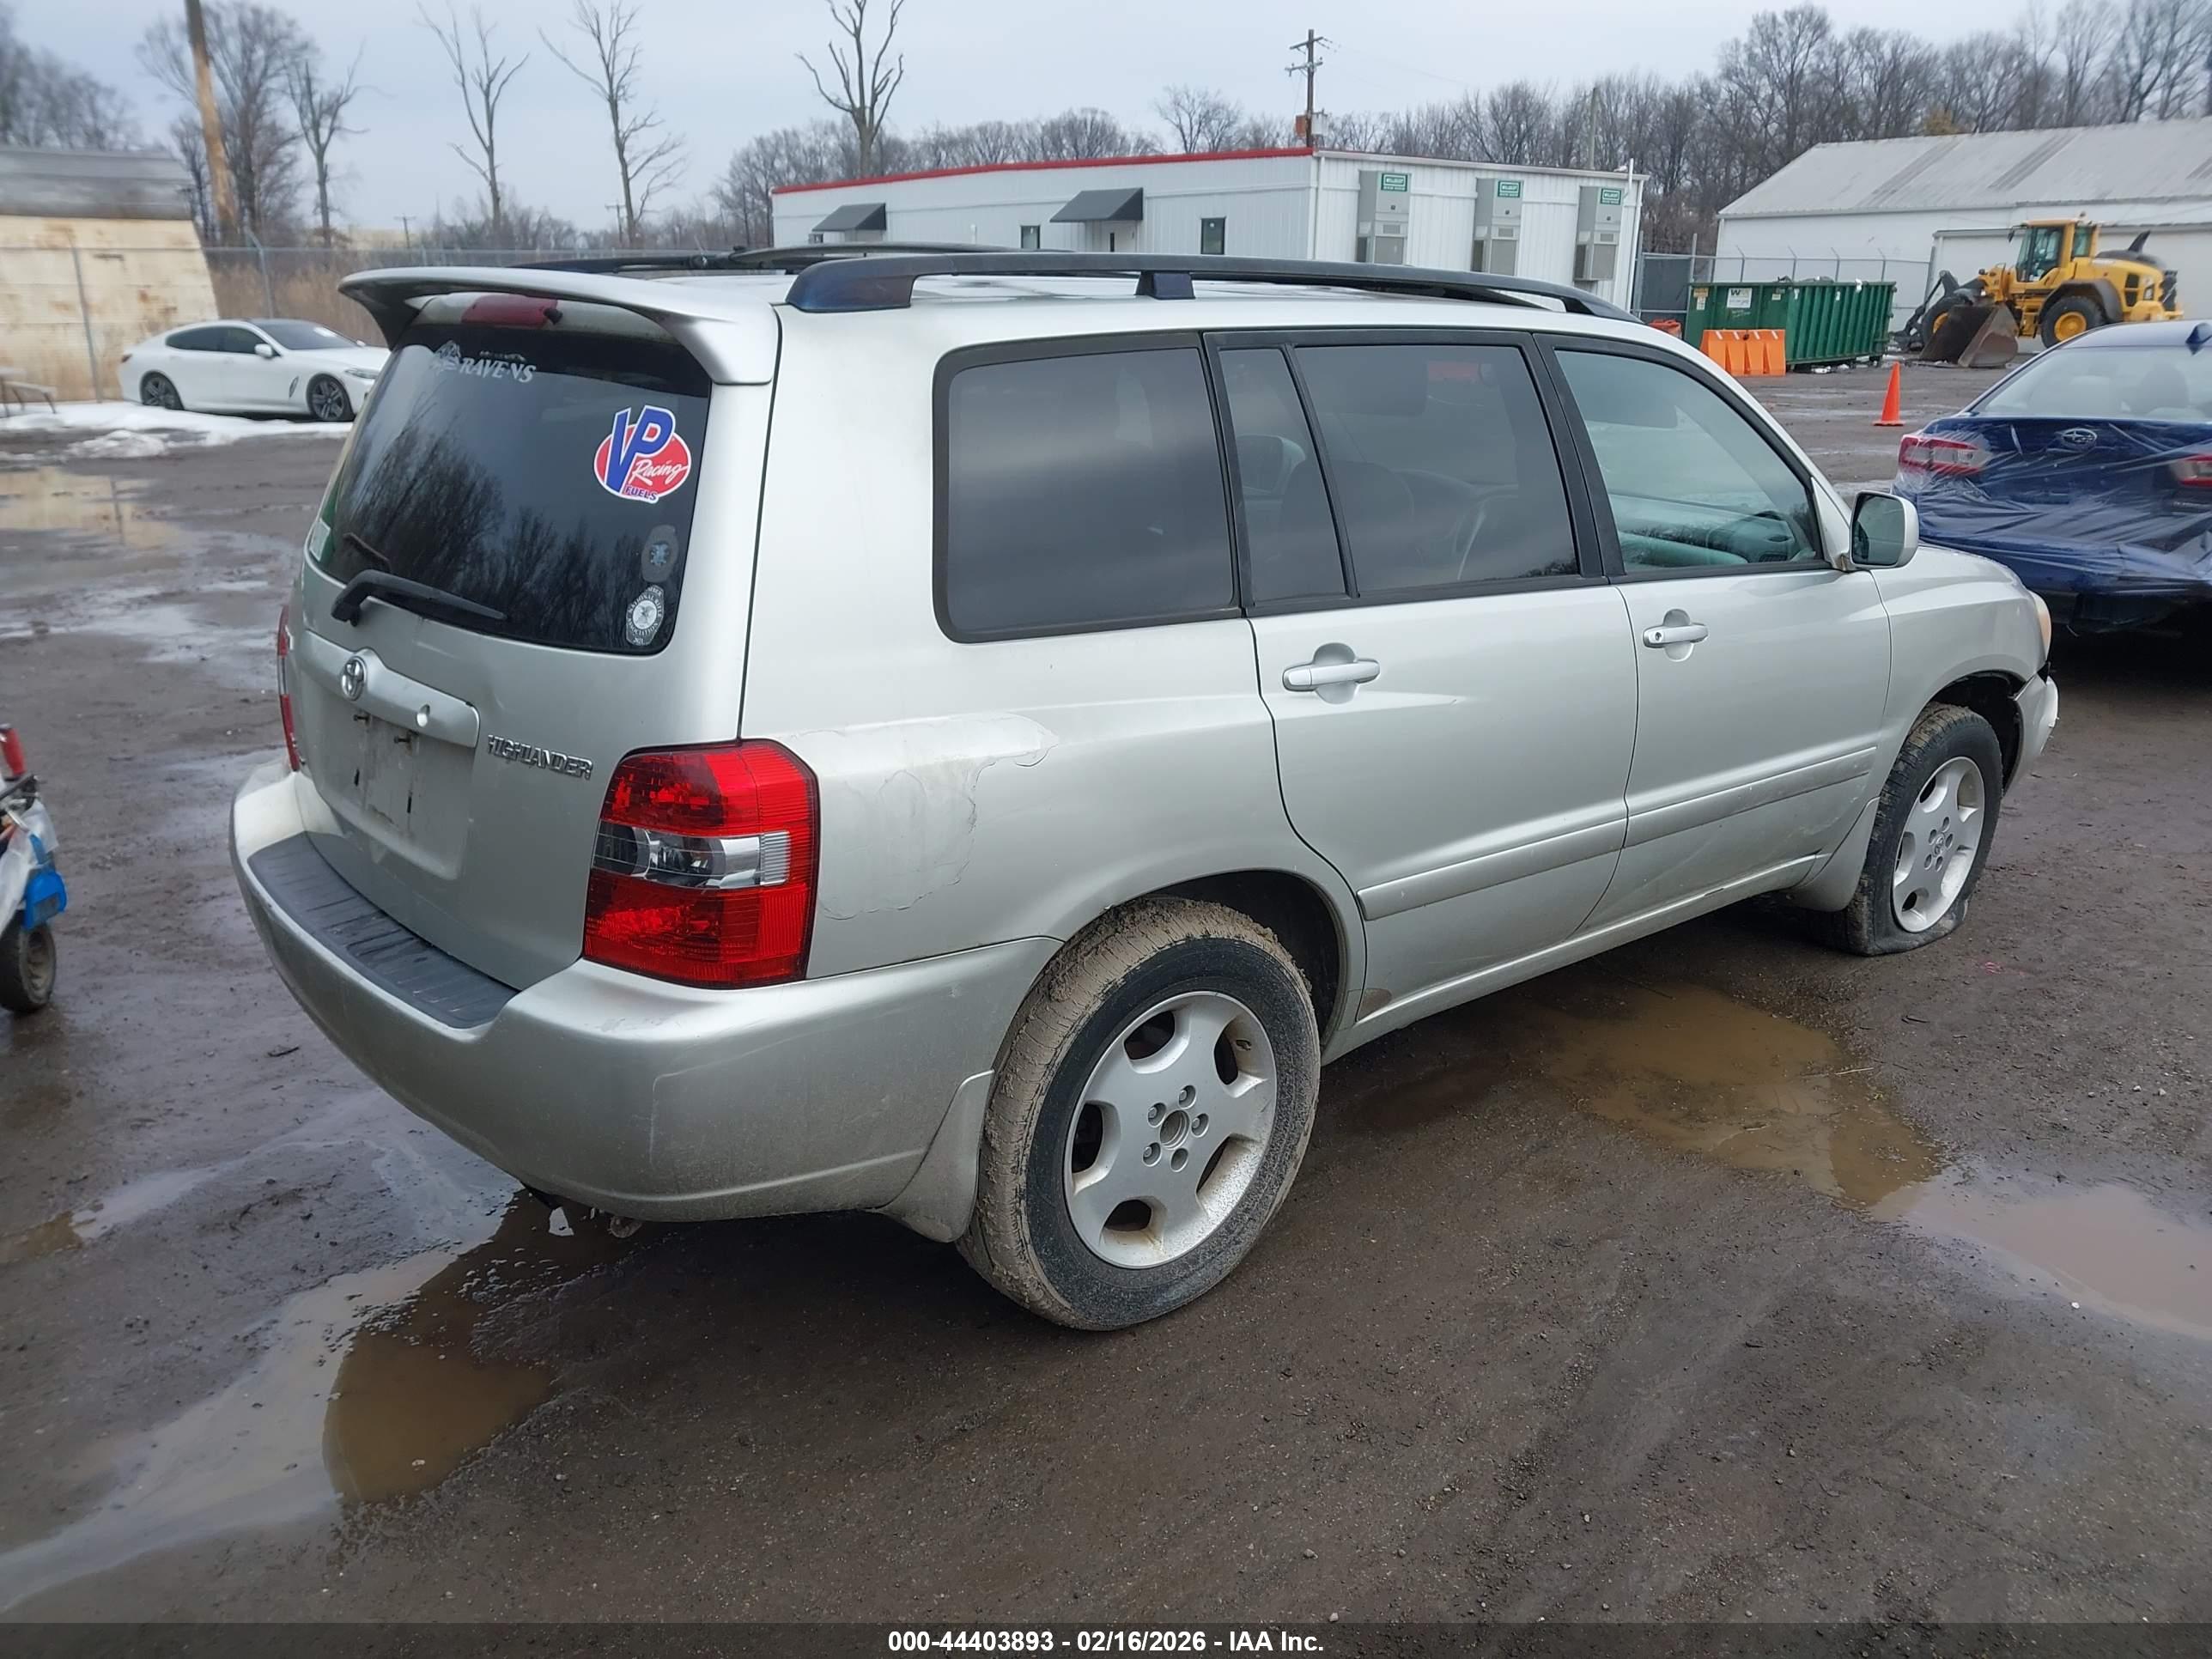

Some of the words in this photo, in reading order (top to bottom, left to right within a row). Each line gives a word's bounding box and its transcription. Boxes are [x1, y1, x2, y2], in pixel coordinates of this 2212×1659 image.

[604, 404, 676, 495] VP
[627, 459, 689, 487] Racing
[624, 485, 659, 501] FUELS
[488, 733, 593, 781] HIGHLANDER
